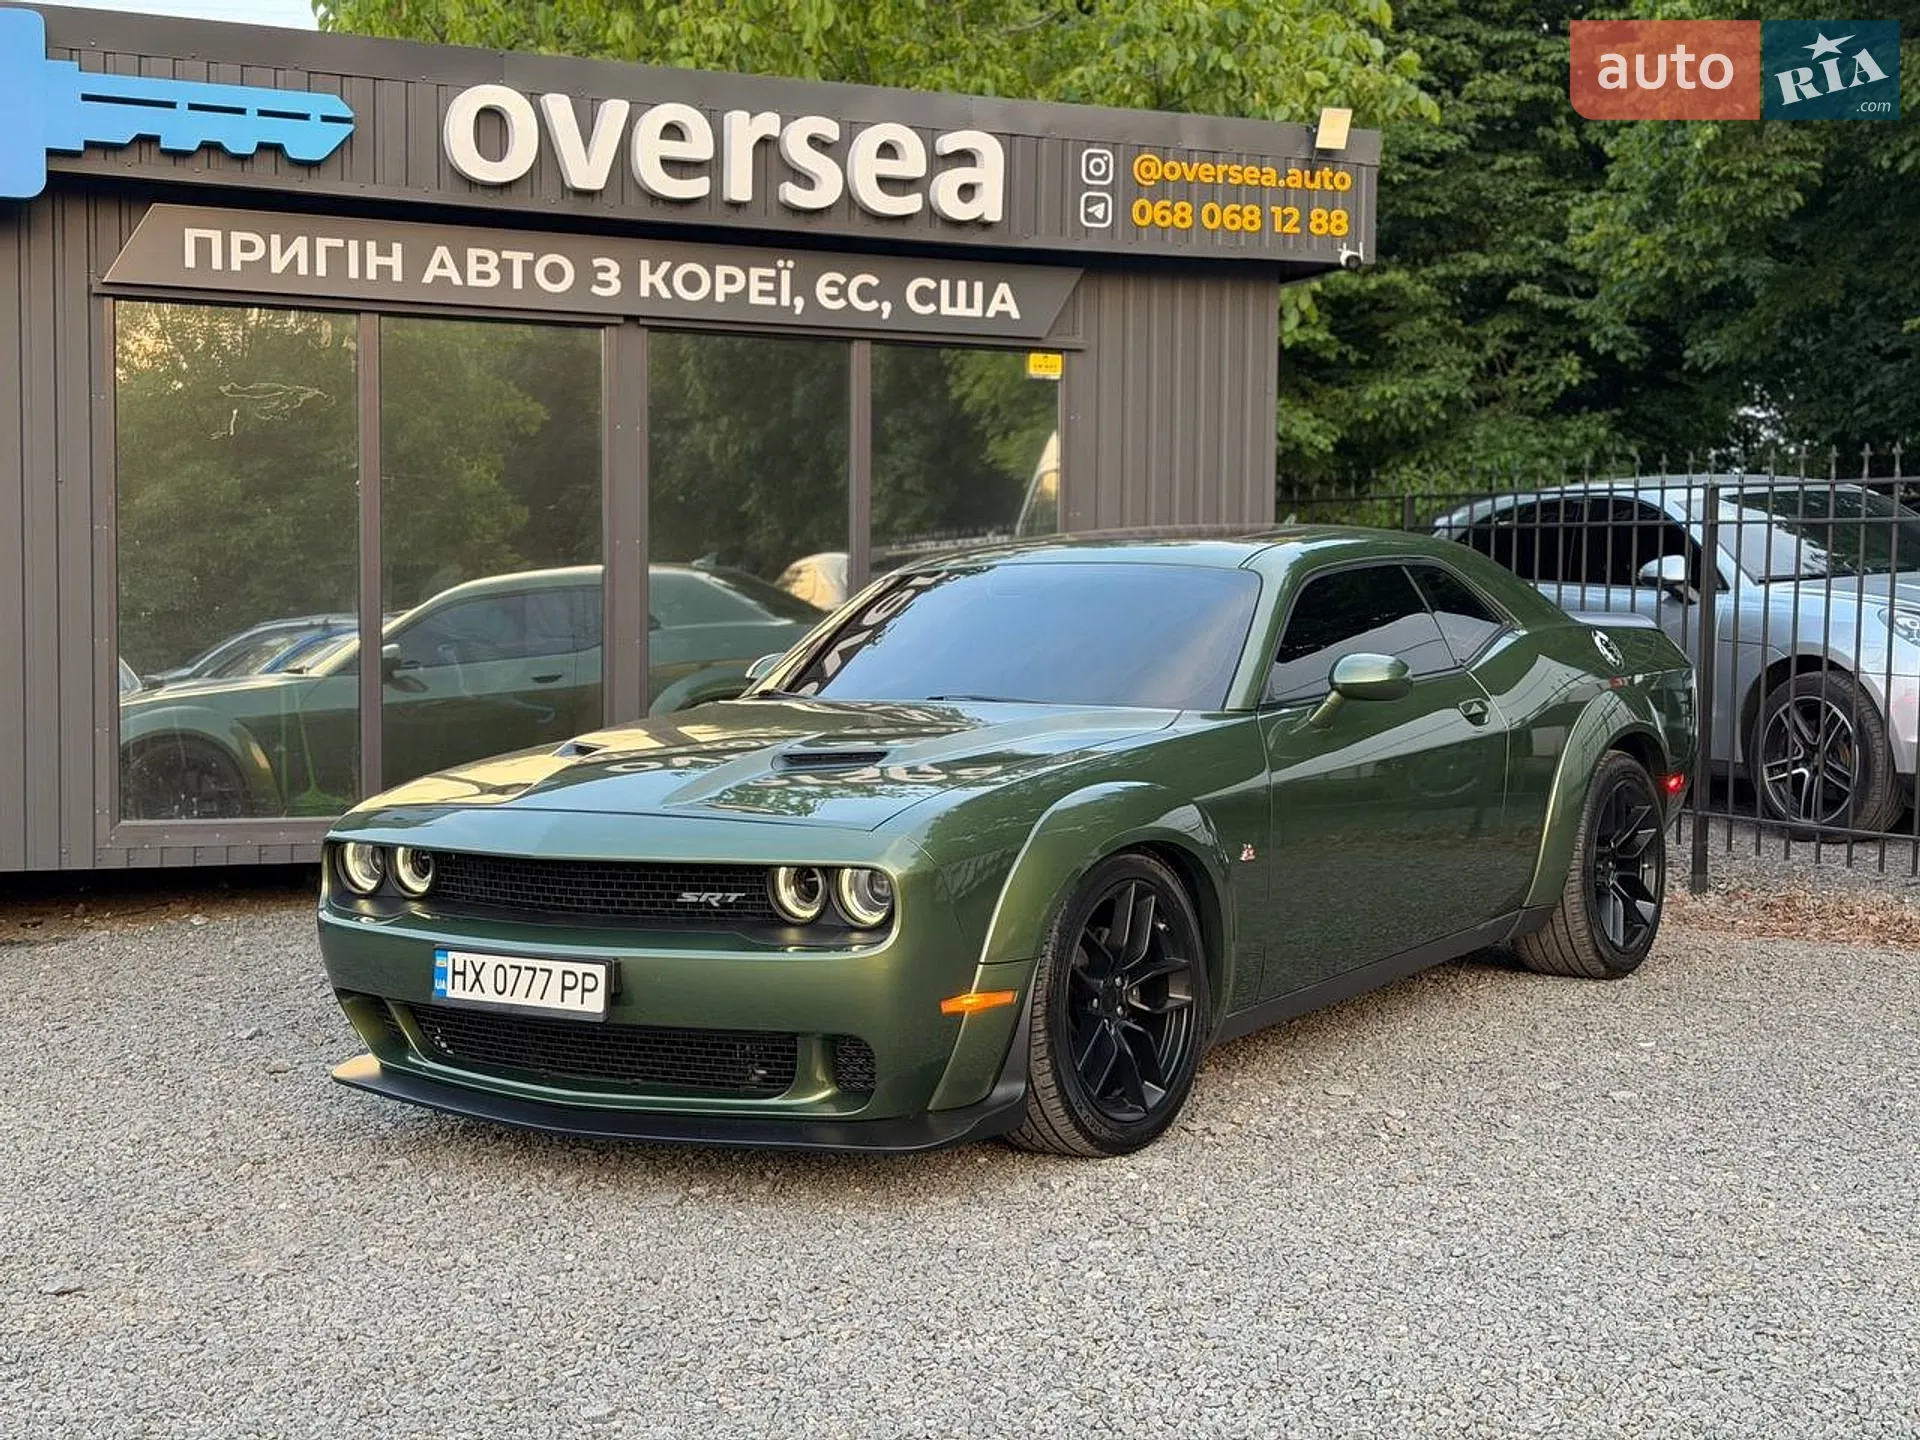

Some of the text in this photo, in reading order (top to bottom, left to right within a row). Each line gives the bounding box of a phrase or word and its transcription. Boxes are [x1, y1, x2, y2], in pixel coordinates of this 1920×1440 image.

[444, 83, 1005, 222] oversea
[1132, 153, 1353, 192] @oversea.auto
[1131, 198, 1349, 237] 068 068 12 88
[183, 227, 404, 283] ПРИГІН
[421, 245, 576, 293] АВТО
[638, 260, 806, 315] КОРЕЇ,
[815, 271, 892, 318] ЄС,
[904, 277, 1021, 320] США
[676, 892, 746, 907] SRT
[451, 958, 599, 1005] HX 0777 PP
